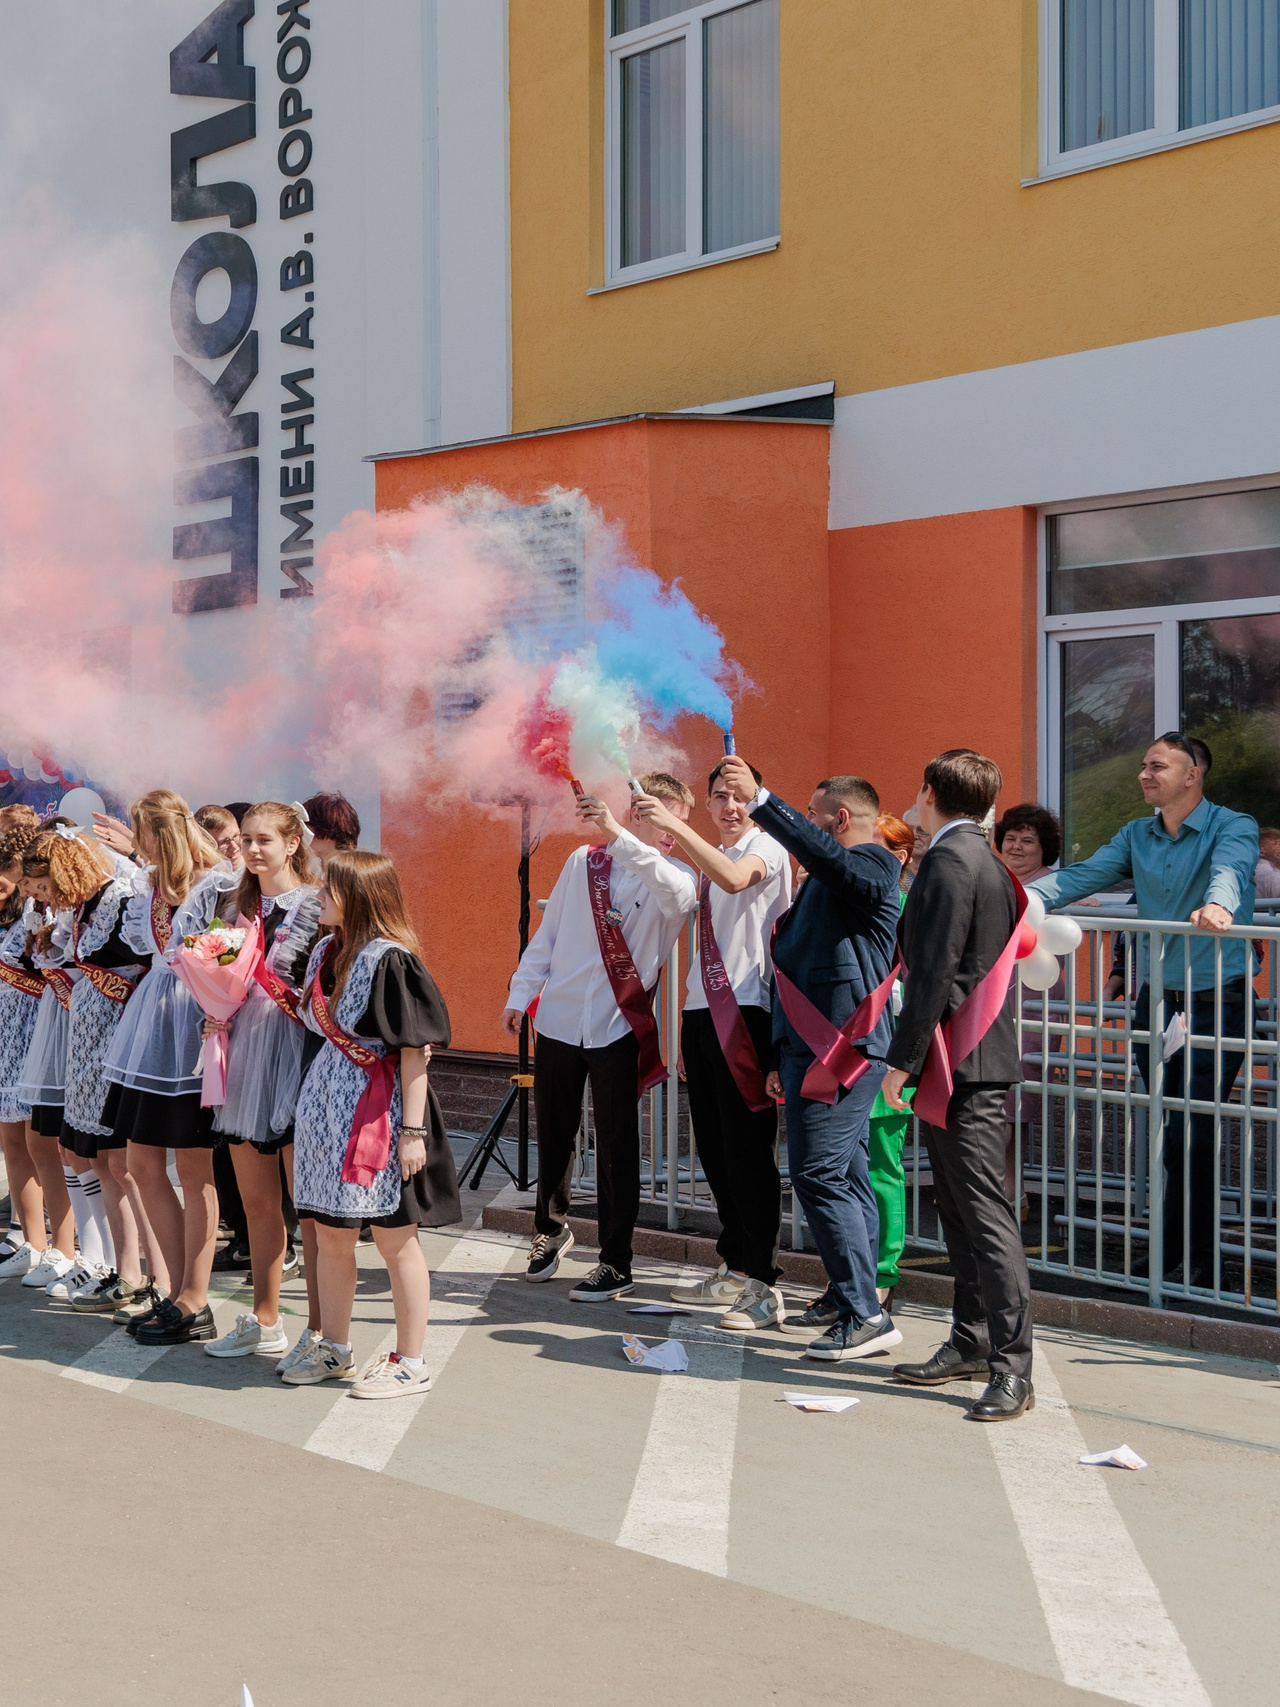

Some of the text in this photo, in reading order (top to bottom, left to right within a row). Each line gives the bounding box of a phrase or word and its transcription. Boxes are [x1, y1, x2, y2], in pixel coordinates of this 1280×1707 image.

[169, 0, 259, 615] ШКОЛА
[279, 231, 314, 349] А.В.
[279, 367, 314, 599] ИМЕНИ
[593, 873, 616, 950] Выпускник
[610, 952, 638, 981] 2025
[706, 961, 730, 991] 2025
[92, 969, 131, 999] 2025
